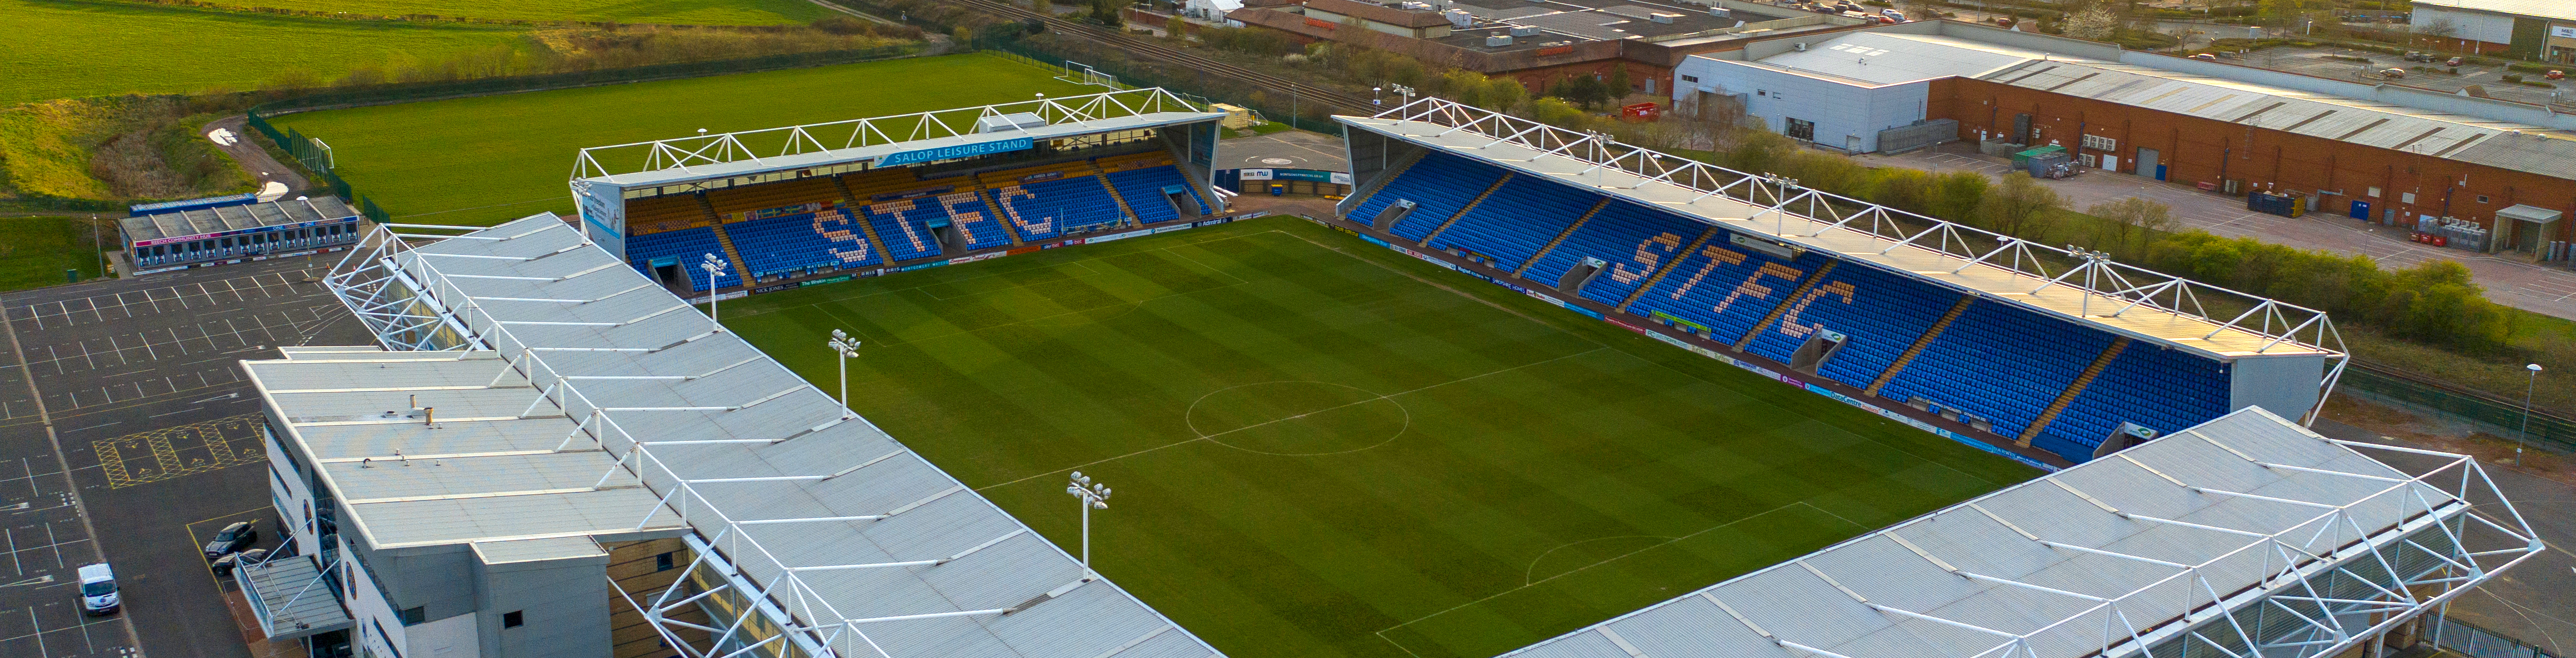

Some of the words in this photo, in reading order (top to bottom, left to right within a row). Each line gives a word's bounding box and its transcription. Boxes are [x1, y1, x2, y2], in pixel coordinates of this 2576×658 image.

[895, 150, 933, 163] SALOP
[938, 143, 985, 158] LEISURE
[989, 139, 1026, 151] STAND
[766, 267, 803, 275] MONTGOMERY
[1458, 266, 1470, 274] Magnet
[1492, 278, 1511, 289] SHROPSHIRE
[1692, 345, 1708, 355] Tuffins
[1714, 353, 1730, 363] Tuffins
[1830, 391, 1862, 407] DataCentre
[1862, 404, 1879, 414] Products
[1993, 446, 2015, 457] DARWIN
